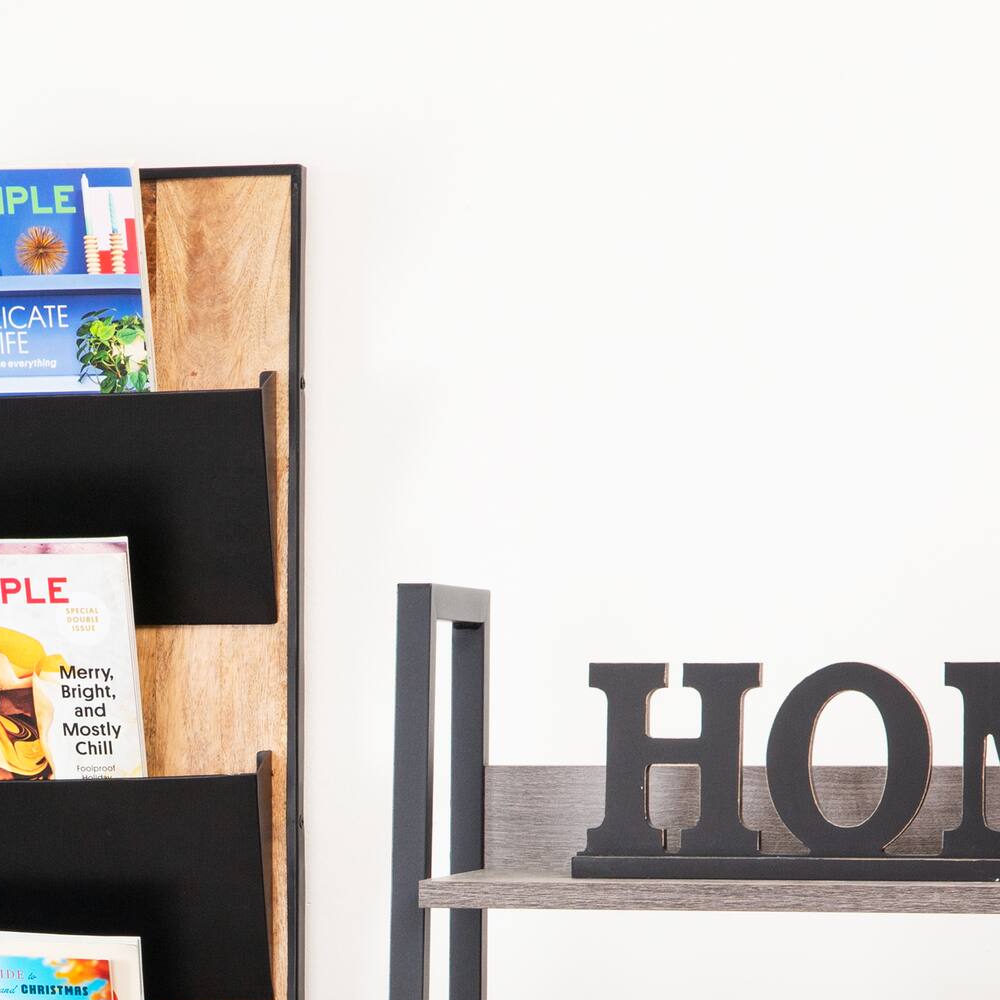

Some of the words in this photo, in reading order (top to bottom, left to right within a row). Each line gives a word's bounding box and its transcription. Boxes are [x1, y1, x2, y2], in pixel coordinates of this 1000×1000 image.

[7, 358, 57, 370] everything
[65, 607, 100, 615] SPECIAL
[66, 616, 100, 624] DOUBLE
[71, 625, 96, 633] ISSUE
[59, 665, 114, 682] Merry,
[61, 683, 116, 702] Bright,
[74, 702, 106, 718] and
[62, 721, 122, 740] Mostly
[75, 740, 113, 756] Chill
[76, 764, 116, 773] Foolproof
[20, 984, 89, 996] CHRISTMAS
